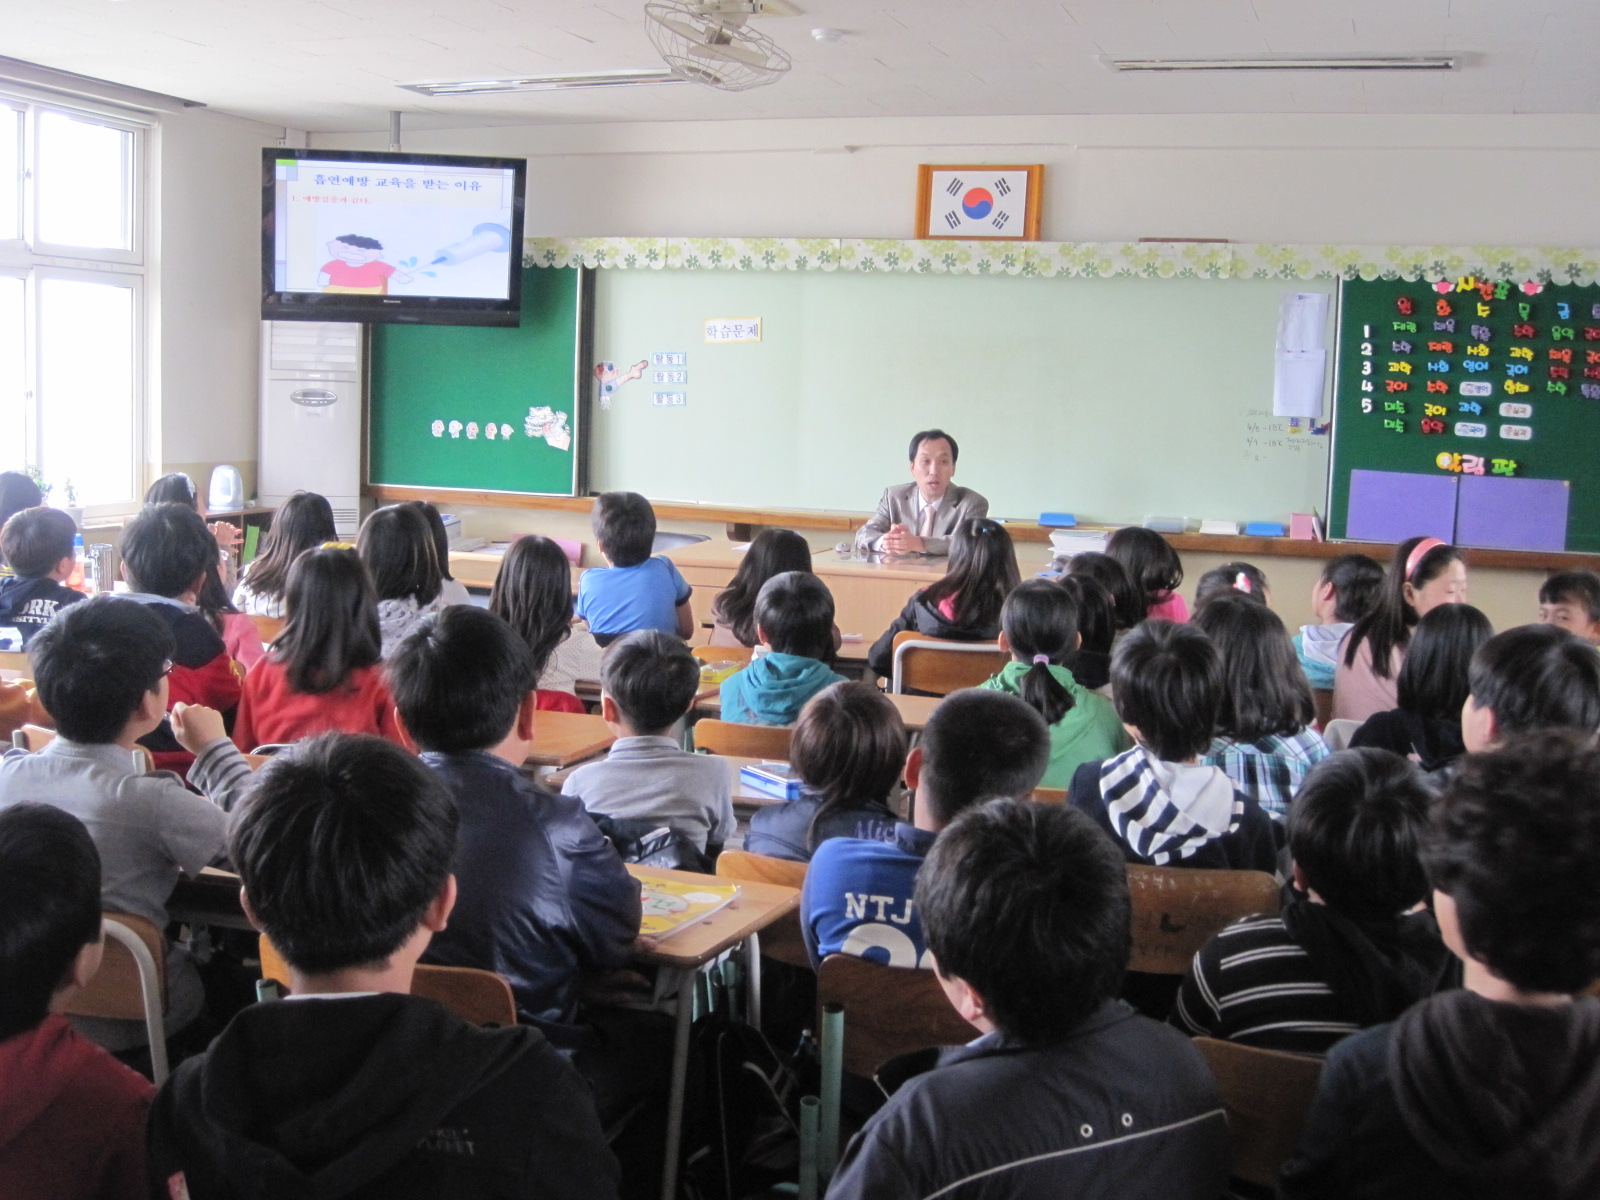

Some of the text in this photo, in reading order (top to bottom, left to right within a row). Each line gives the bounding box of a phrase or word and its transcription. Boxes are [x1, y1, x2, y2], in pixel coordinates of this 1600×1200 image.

[314, 173, 482, 192] 흡연예방 교육을 받는 이유
[1557, 302, 1571, 320] 금
[705, 323, 759, 339] 학습문제
[1363, 324, 1371, 339] 1
[1361, 343, 1373, 356] 2
[1361, 361, 1373, 375] 3
[1463, 359, 1489, 372] 영어
[1506, 363, 1529, 377] 국어
[1361, 380, 1374, 392] 4
[1385, 379, 1409, 393] 국어
[1361, 398, 1373, 414] 5
[1424, 403, 1447, 417] 국어
